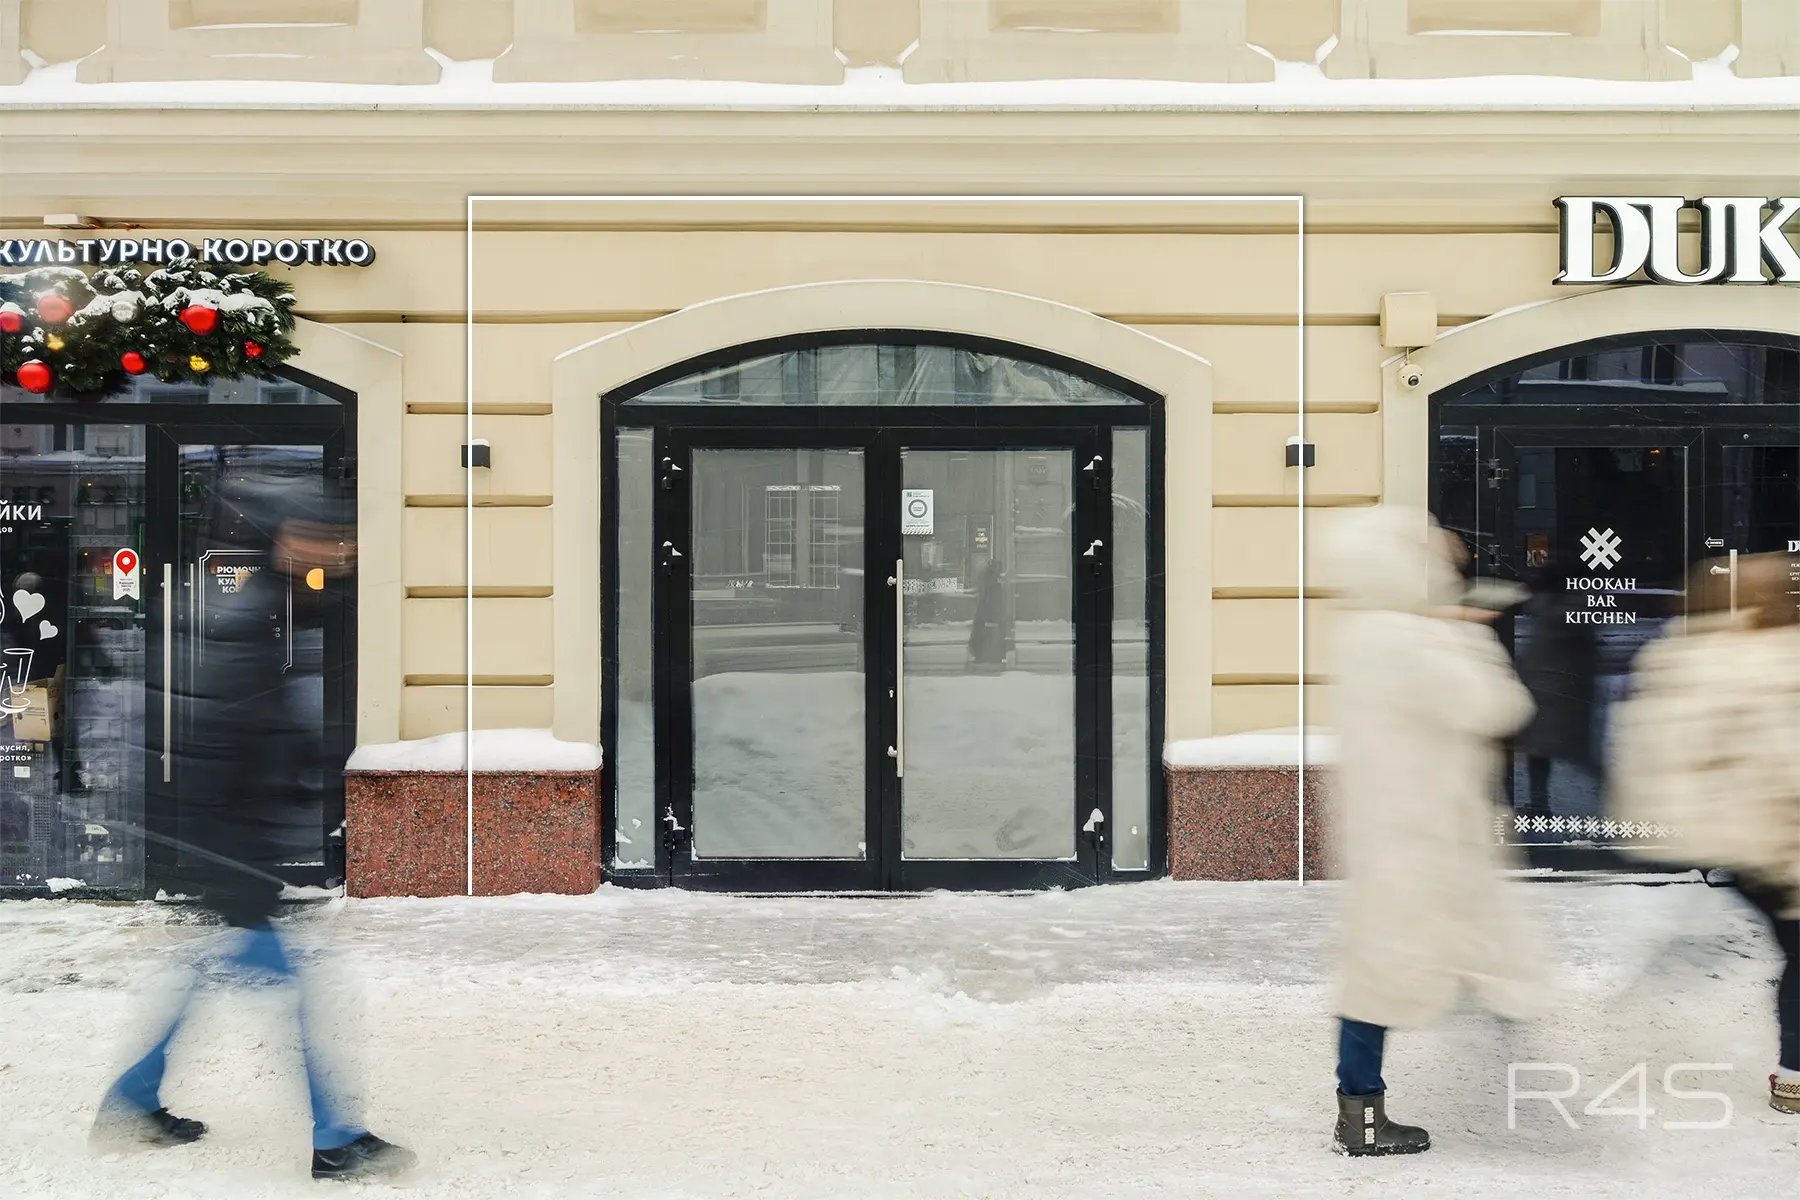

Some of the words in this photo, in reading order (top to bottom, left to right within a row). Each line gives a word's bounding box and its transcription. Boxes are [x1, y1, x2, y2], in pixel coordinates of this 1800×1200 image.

[1553, 196, 1800, 285] DUK
[0, 239, 191, 264] КУЛЬТУРНО
[203, 239, 371, 264] КОРОТКО
[1787, 540, 1800, 552] D
[1566, 577, 1636, 590] HOOKAH
[1587, 594, 1617, 608] BAR
[1565, 611, 1637, 624] KITCHEN
